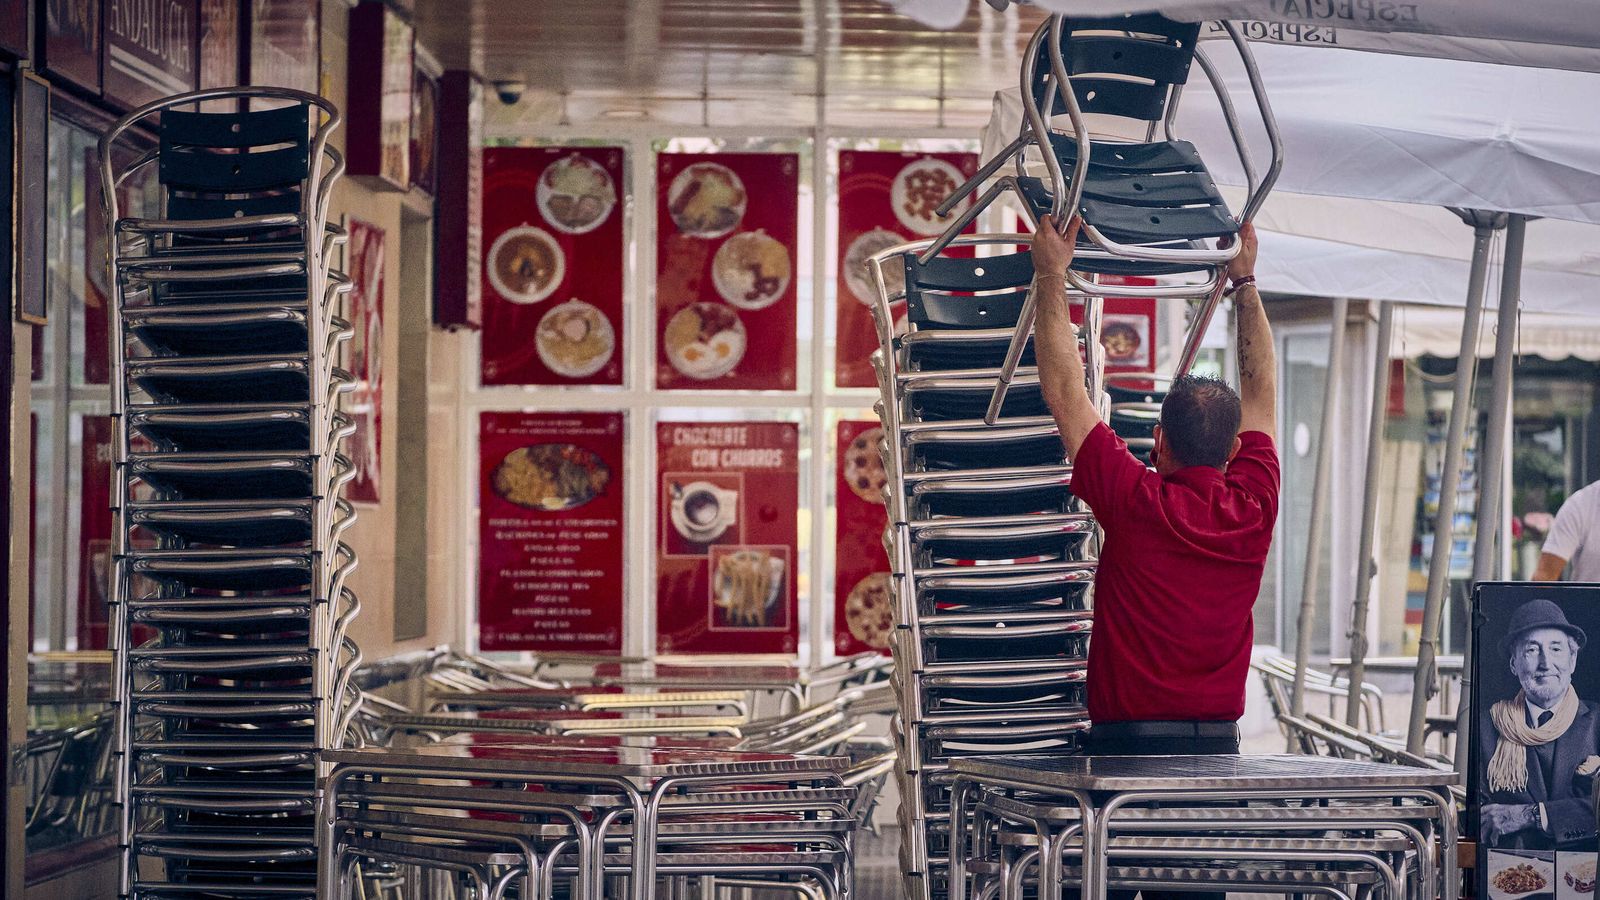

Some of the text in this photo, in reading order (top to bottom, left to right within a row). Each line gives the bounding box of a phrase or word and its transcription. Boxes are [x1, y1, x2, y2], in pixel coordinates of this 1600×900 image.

[673, 427, 747, 446] CHOCOLATE
[691, 448, 783, 468] CON CHURROS
